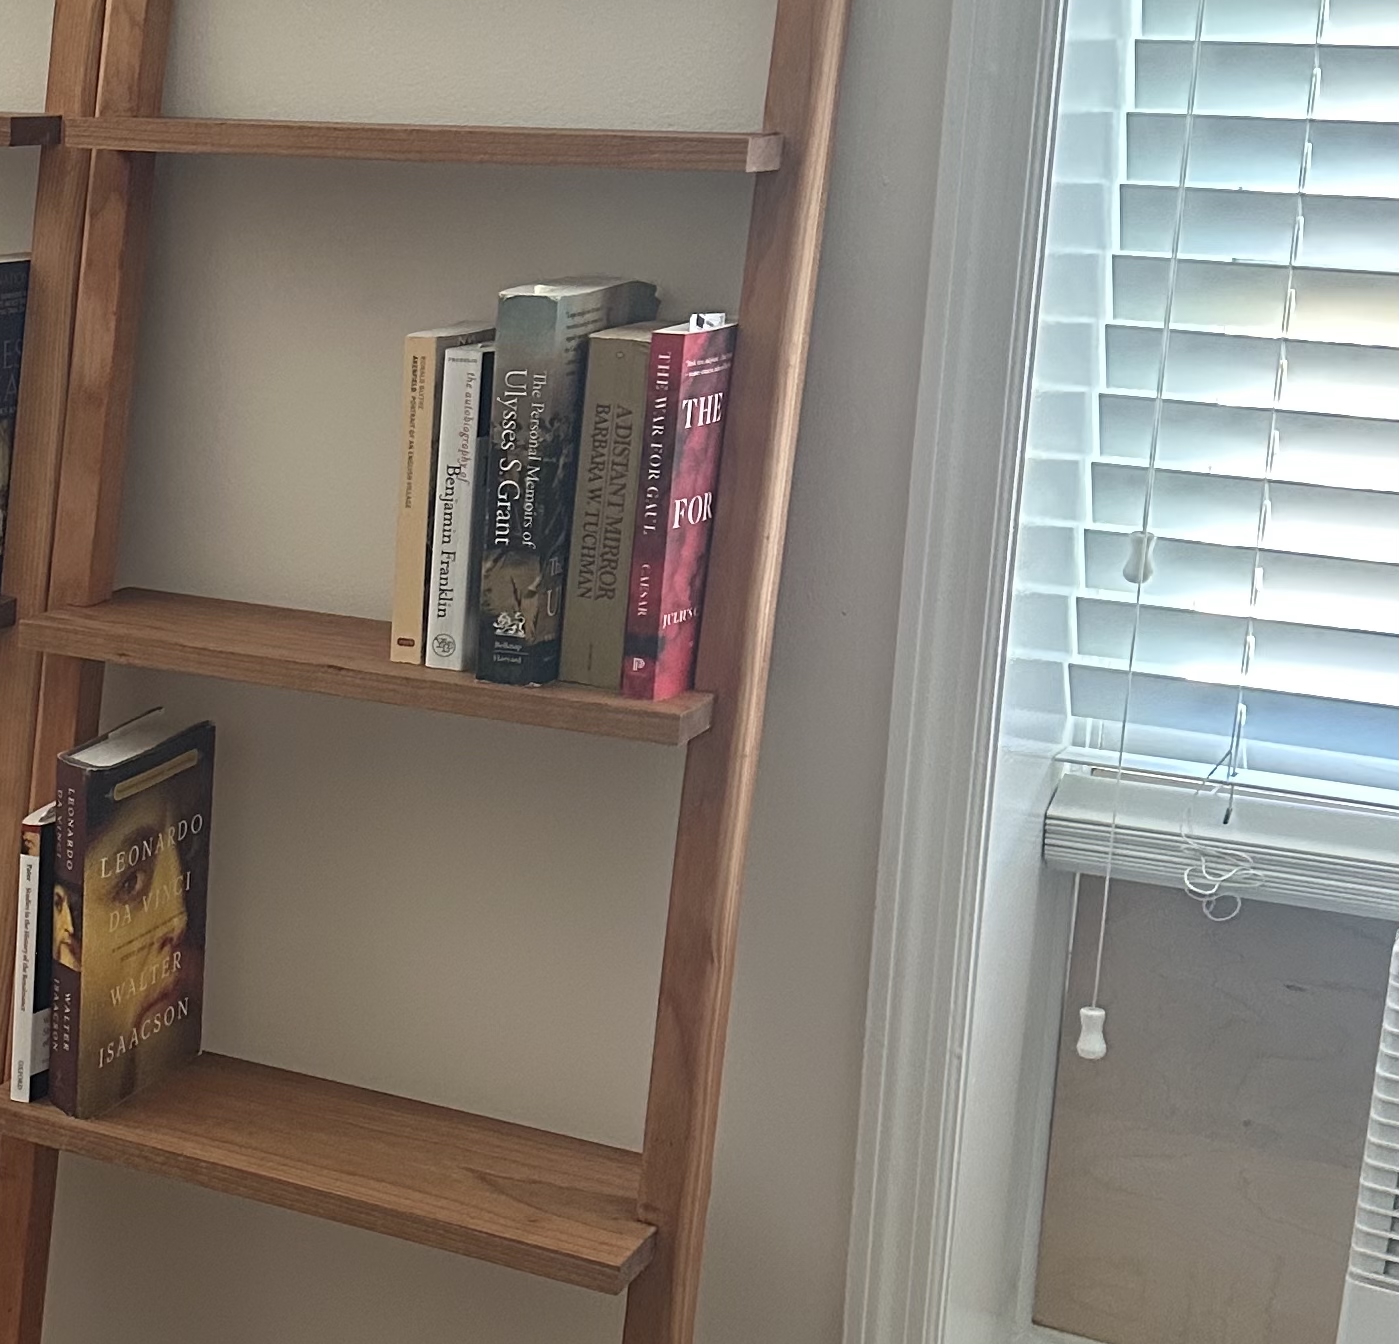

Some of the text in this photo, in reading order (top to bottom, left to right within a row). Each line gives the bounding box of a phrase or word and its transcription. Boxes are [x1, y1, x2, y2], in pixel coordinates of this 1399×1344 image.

[408, 430, 416, 439] OF
[457, 372, 476, 485] the autobiography of
[681, 392, 724, 430] THE
[406, 451, 414, 481] ENGLISH
[408, 440, 415, 450] AN
[494, 369, 528, 546] Ulysses S. Grant
[521, 372, 547, 550] The Personal Memoirs of
[577, 403, 611, 600] BARBARA W. TUCHMAN
[595, 404, 633, 601] A DISTANT MIRROR
[636, 351, 671, 617] THE WAR FOR GAUL CAESAR
[672, 491, 713, 530] FOR
[437, 464, 462, 619] Benjamin Franklin
[661, 608, 693, 630] JULIUS
[56, 789, 63, 810] DA
[66, 787, 75, 870] LEONARDO
[100, 813, 203, 879] LEONARDO
[24, 887, 32, 910] Studies
[24, 911, 30, 919] in
[107, 910, 132, 934] DA
[141, 871, 191, 914] VINCI
[22, 930, 30, 954] History
[110, 951, 182, 1007] WALTER
[51, 978, 60, 1051] ISAACSON
[62, 993, 71, 1052] WALTER
[97, 997, 189, 1070] ISAACSON
